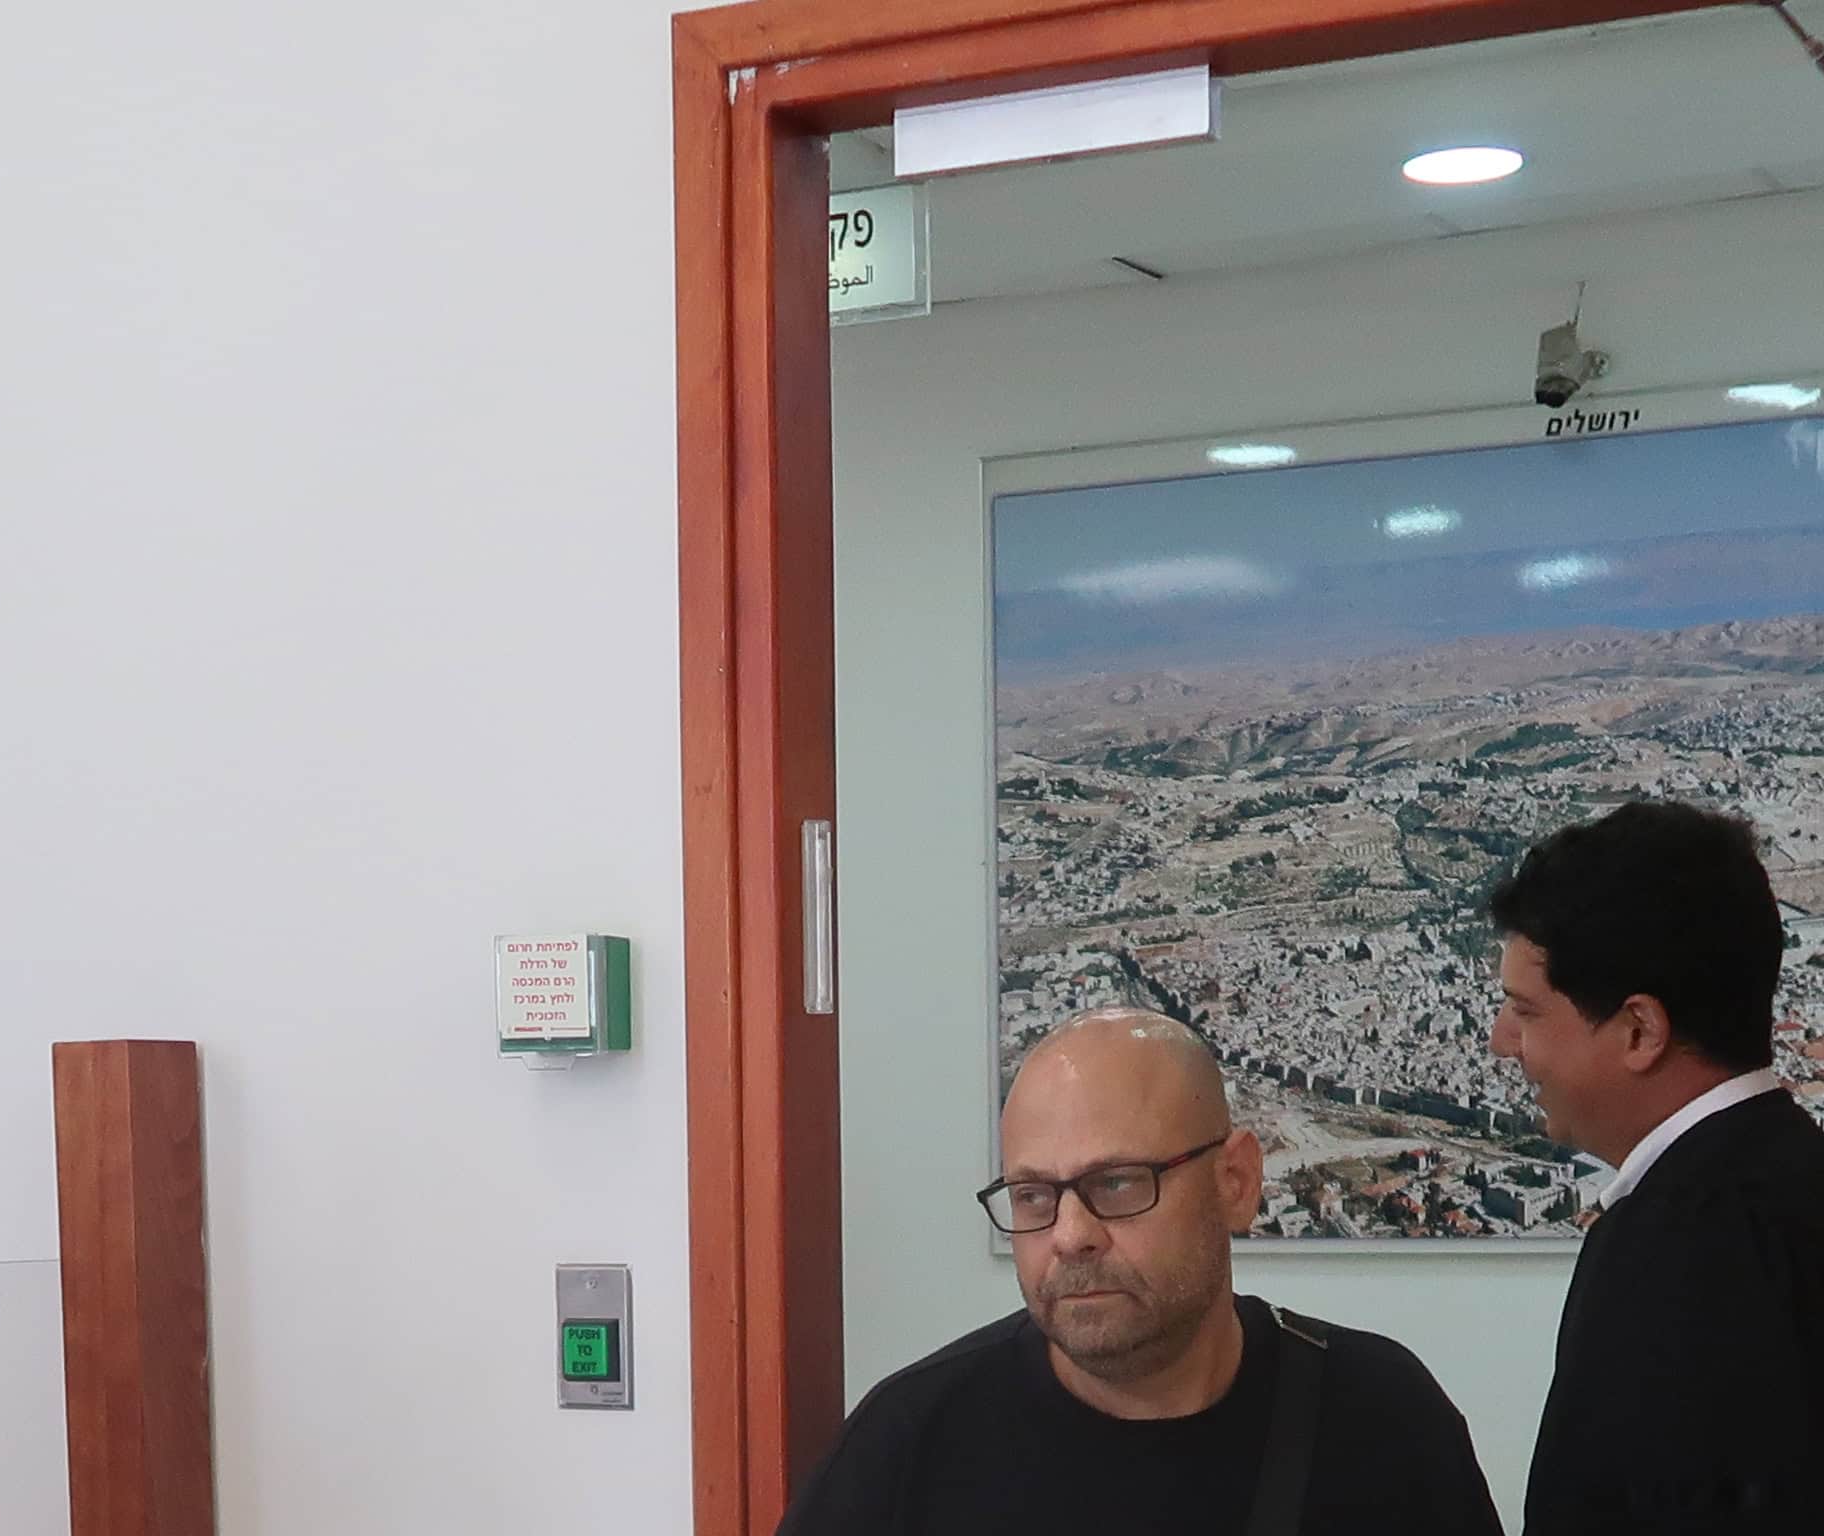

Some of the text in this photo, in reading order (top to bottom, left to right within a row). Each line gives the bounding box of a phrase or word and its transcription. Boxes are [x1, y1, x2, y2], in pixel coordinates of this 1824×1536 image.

[1546, 408, 1640, 436] ירושלים
[507, 940, 578, 953] לפתיחת חרום
[520, 958, 567, 970] של הדלת
[511, 976, 576, 987] הרם המכסה
[513, 993, 574, 1006] ולחץ במרכז
[526, 1011, 567, 1022] הזכוכית
[567, 1328, 601, 1340] PUSH
[577, 1344, 593, 1357] TO
[571, 1361, 598, 1373] EXIT
